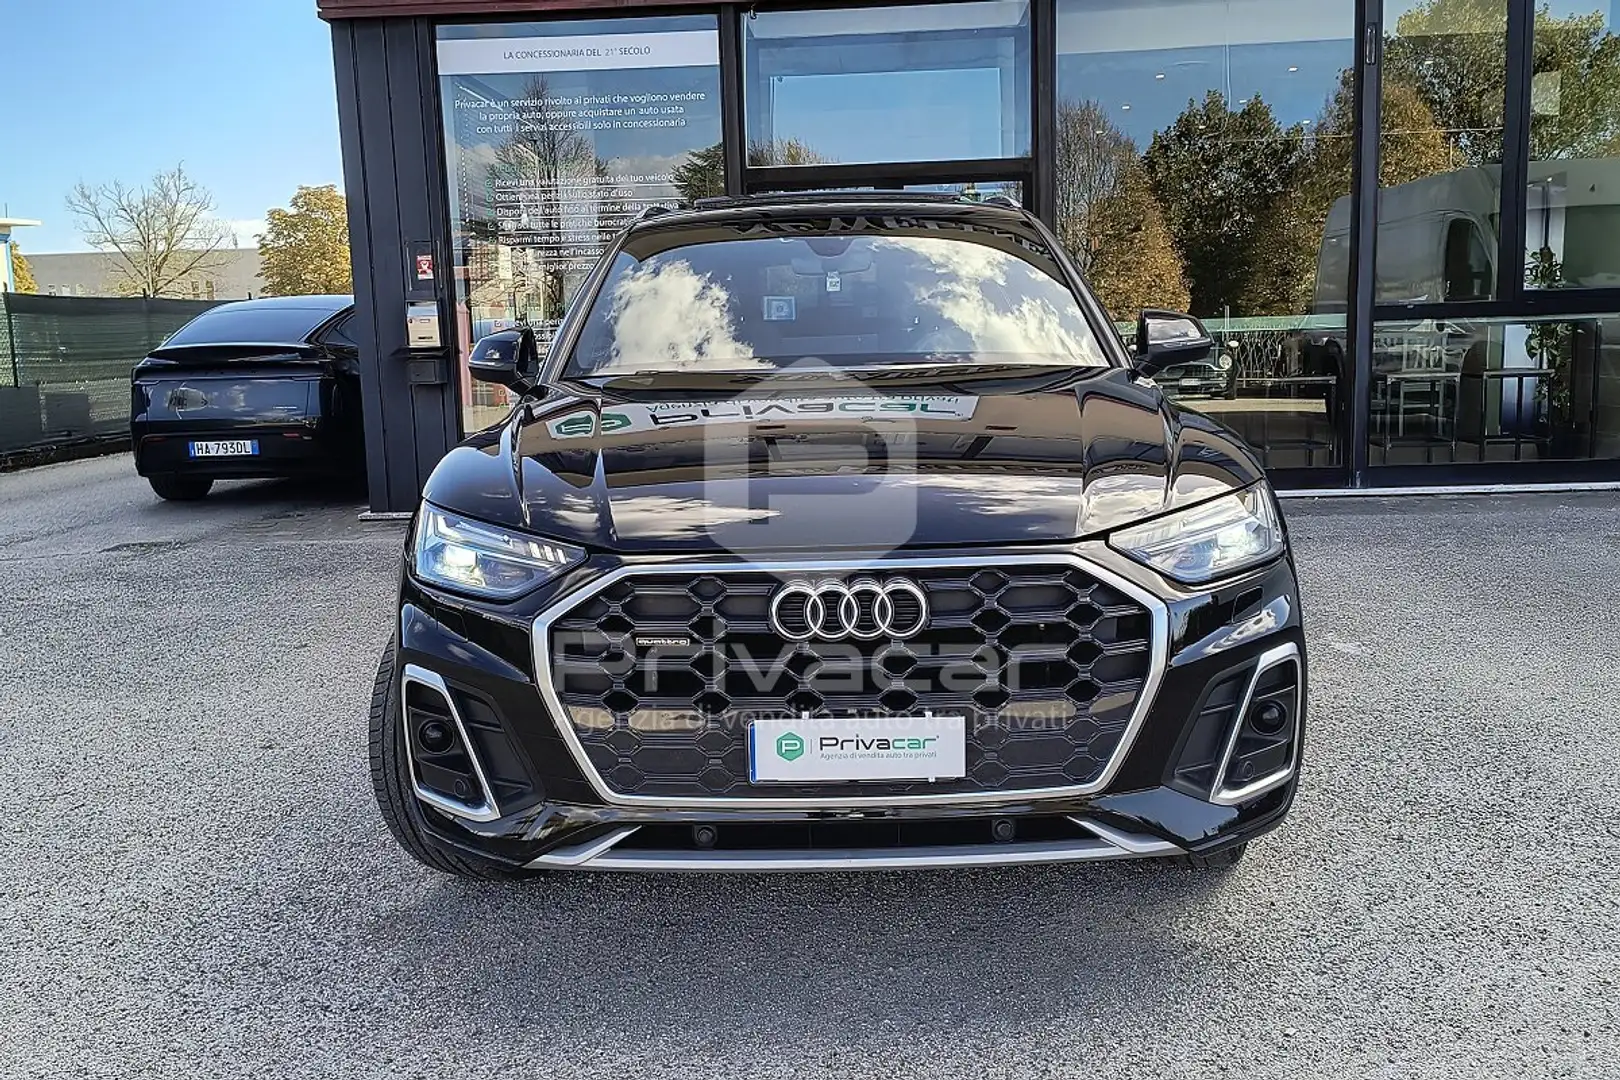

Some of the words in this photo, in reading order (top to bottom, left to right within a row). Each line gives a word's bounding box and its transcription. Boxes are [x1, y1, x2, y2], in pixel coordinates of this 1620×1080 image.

[503, 51, 514, 60] LA
[515, 48, 585, 60] CONCESSIONARIA
[586, 48, 602, 57] DEL
[619, 45, 651, 56] SECOLO
[454, 99, 489, 109] Privacar
[498, 99, 509, 108] un
[510, 96, 543, 107] servizio
[544, 95, 573, 105] rivolto
[583, 94, 611, 106] privati
[612, 93, 629, 103] che
[629, 92, 668, 104] vogliono
[669, 90, 706, 101] vendere
[479, 111, 488, 121] la
[488, 111, 520, 122] propria
[545, 110, 576, 121] oppure
[578, 107, 623, 119] acquistare
[624, 107, 636, 116] un
[638, 105, 659, 115] auto
[660, 104, 685, 114] usata
[476, 126, 493, 134] con
[493, 124, 513, 134] tutti
[548, 120, 592, 132] accessibili
[593, 120, 612, 130] solo
[613, 119, 621, 129] in
[622, 117, 686, 129] concessionaria
[630, 173, 644, 182] tuo
[644, 172, 674, 182] veicolo
[533, 234, 560, 244] tempo
[195, 442, 211, 456] HA
[214, 441, 251, 455] 793DL
[638, 637, 688, 647] quattro
[819, 733, 938, 751] Privacar
[820, 752, 848, 760] Agenzia
[849, 751, 857, 759] di
[858, 751, 885, 760] vendita
[885, 751, 903, 759] auto
[903, 751, 914, 759] tra
[914, 751, 938, 760] privati
